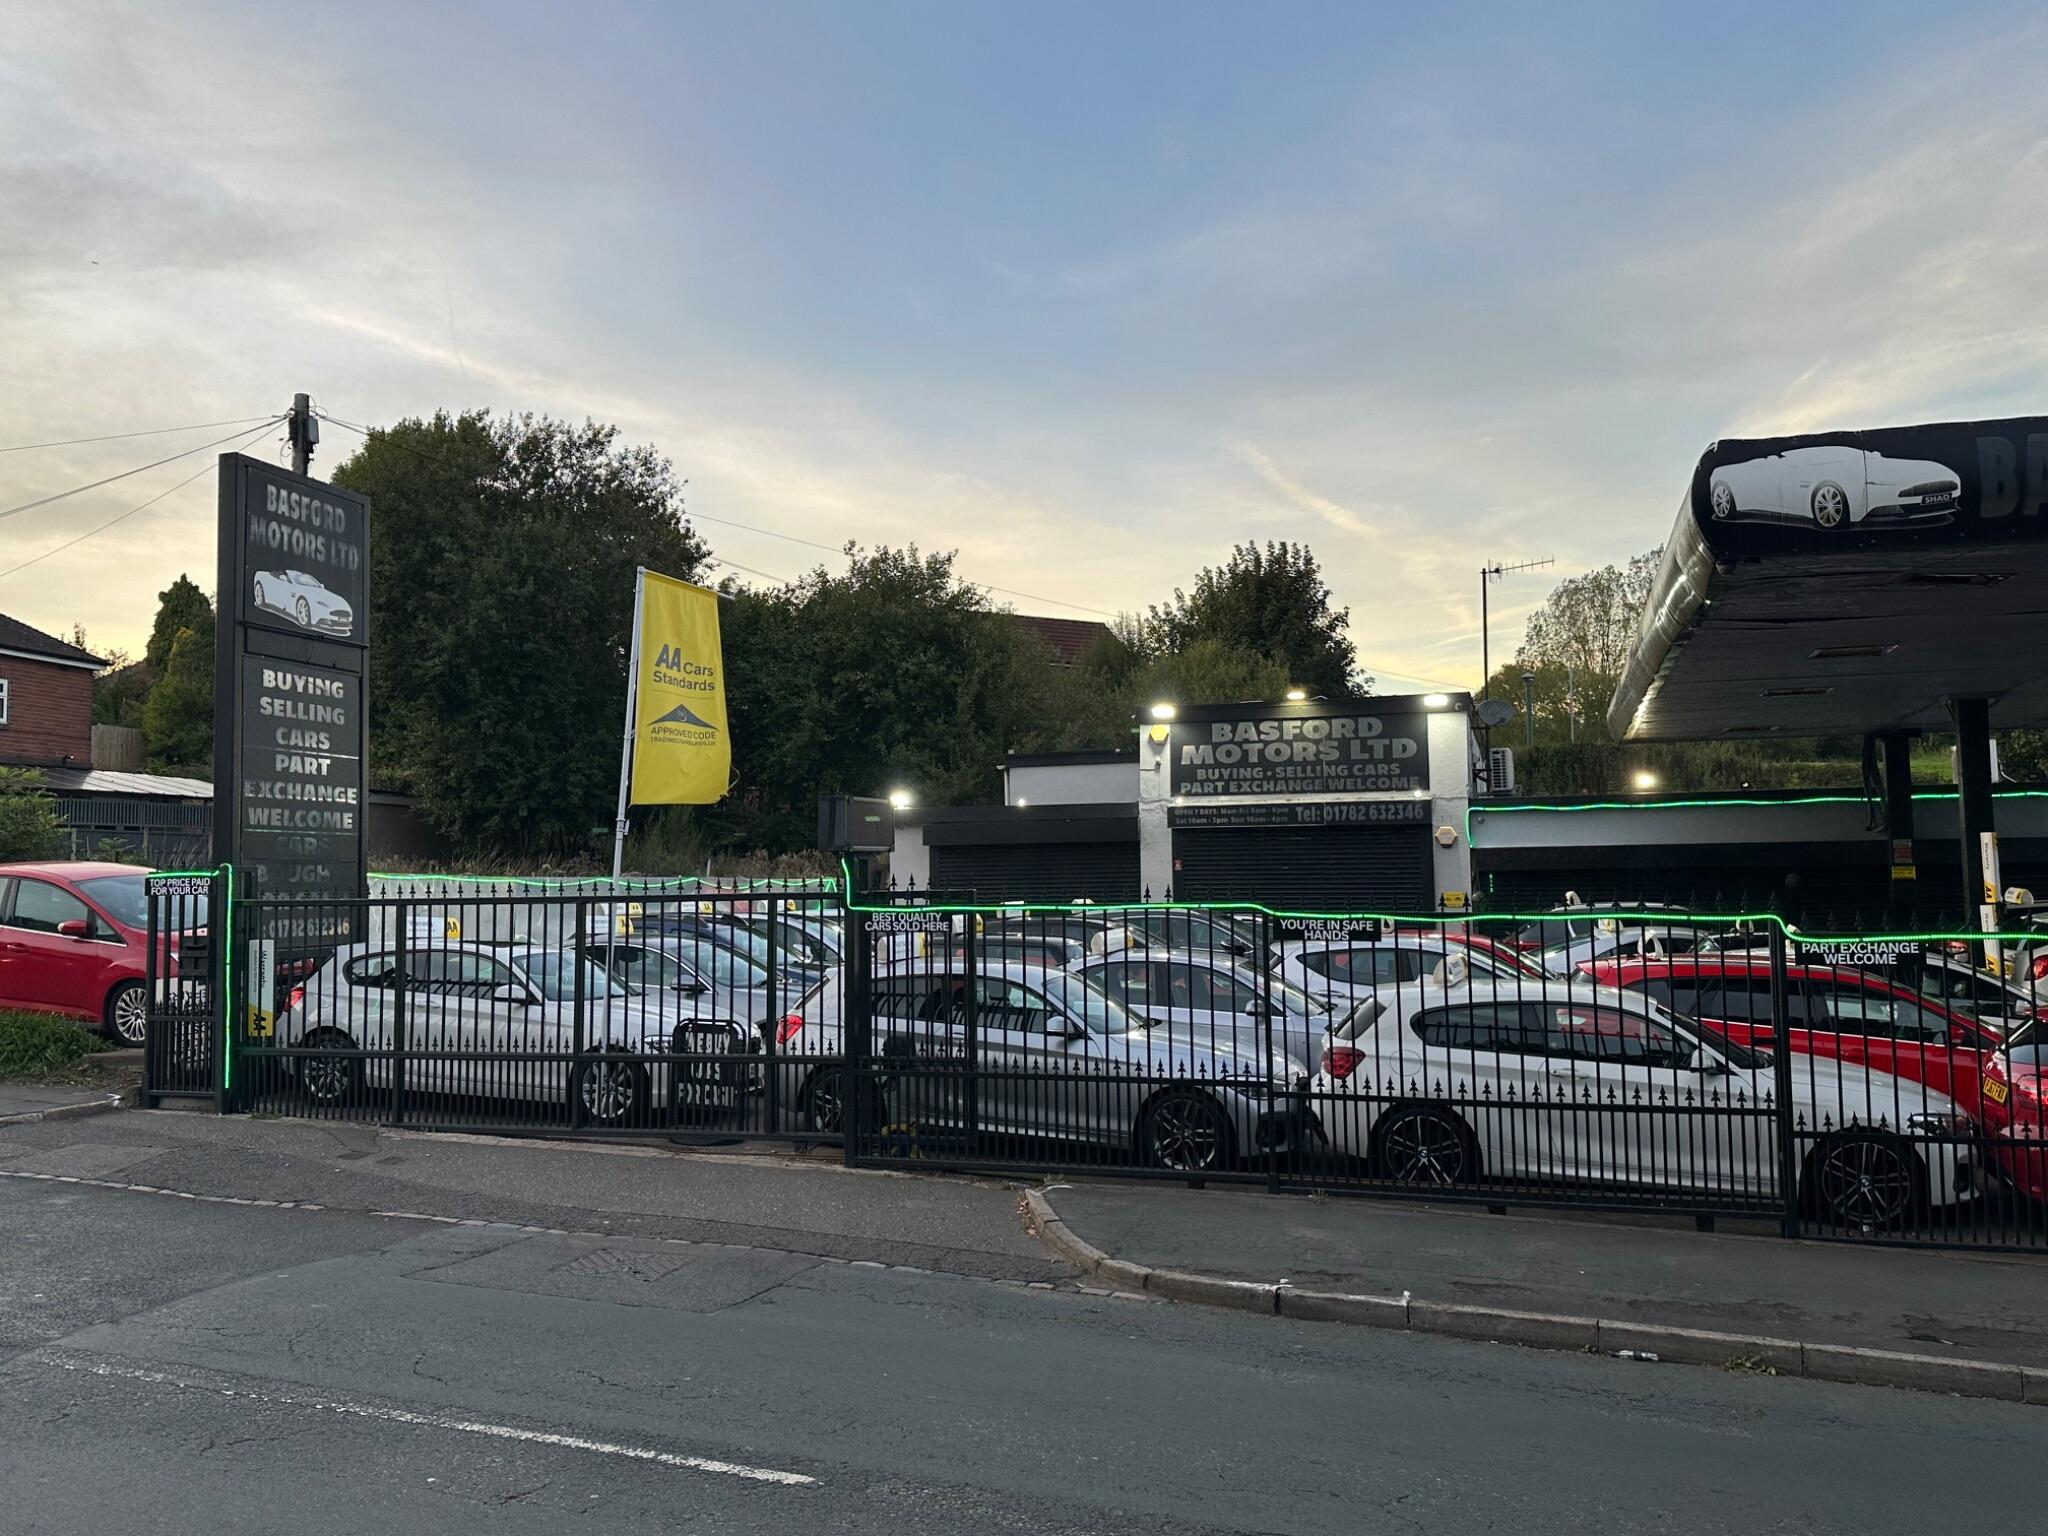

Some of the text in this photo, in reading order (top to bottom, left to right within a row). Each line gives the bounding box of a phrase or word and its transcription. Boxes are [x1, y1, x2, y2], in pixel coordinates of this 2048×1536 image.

[266, 484, 347, 533] BASFORD
[250, 514, 359, 571] MOTORS LTD
[654, 643, 714, 678] AA Cars
[262, 669, 344, 699] BUYING
[653, 670, 716, 692] Standards
[259, 696, 345, 725] SELLING
[275, 727, 331, 750] CARS
[650, 726, 717, 741] APPROVED CODE
[1211, 716, 1384, 743] BASFORD
[1180, 737, 1418, 766] MOTORS LTD
[275, 753, 331, 776] PART
[1196, 763, 1401, 781] BUYING SELLING CARS
[243, 779, 358, 805] EXCHANGE
[1180, 776, 1420, 794] PART EXCHANGE WELCOME
[248, 807, 354, 830] WELCOME
[1295, 803, 1424, 822] Tel: 01782 632346
[149, 878, 211, 887] TOP PRICE PAID
[151, 886, 209, 896] FOR YOUR CAR
[864, 921, 950, 931] CARS SOLD HERE
[872, 912, 942, 922] BEST QUALITY
[1280, 919, 1375, 931] YOU'RE IN SAFE
[1304, 930, 1350, 940] HANDS
[1801, 942, 1920, 954] PART EXCHANGE
[1823, 953, 1898, 965] WELCOME
